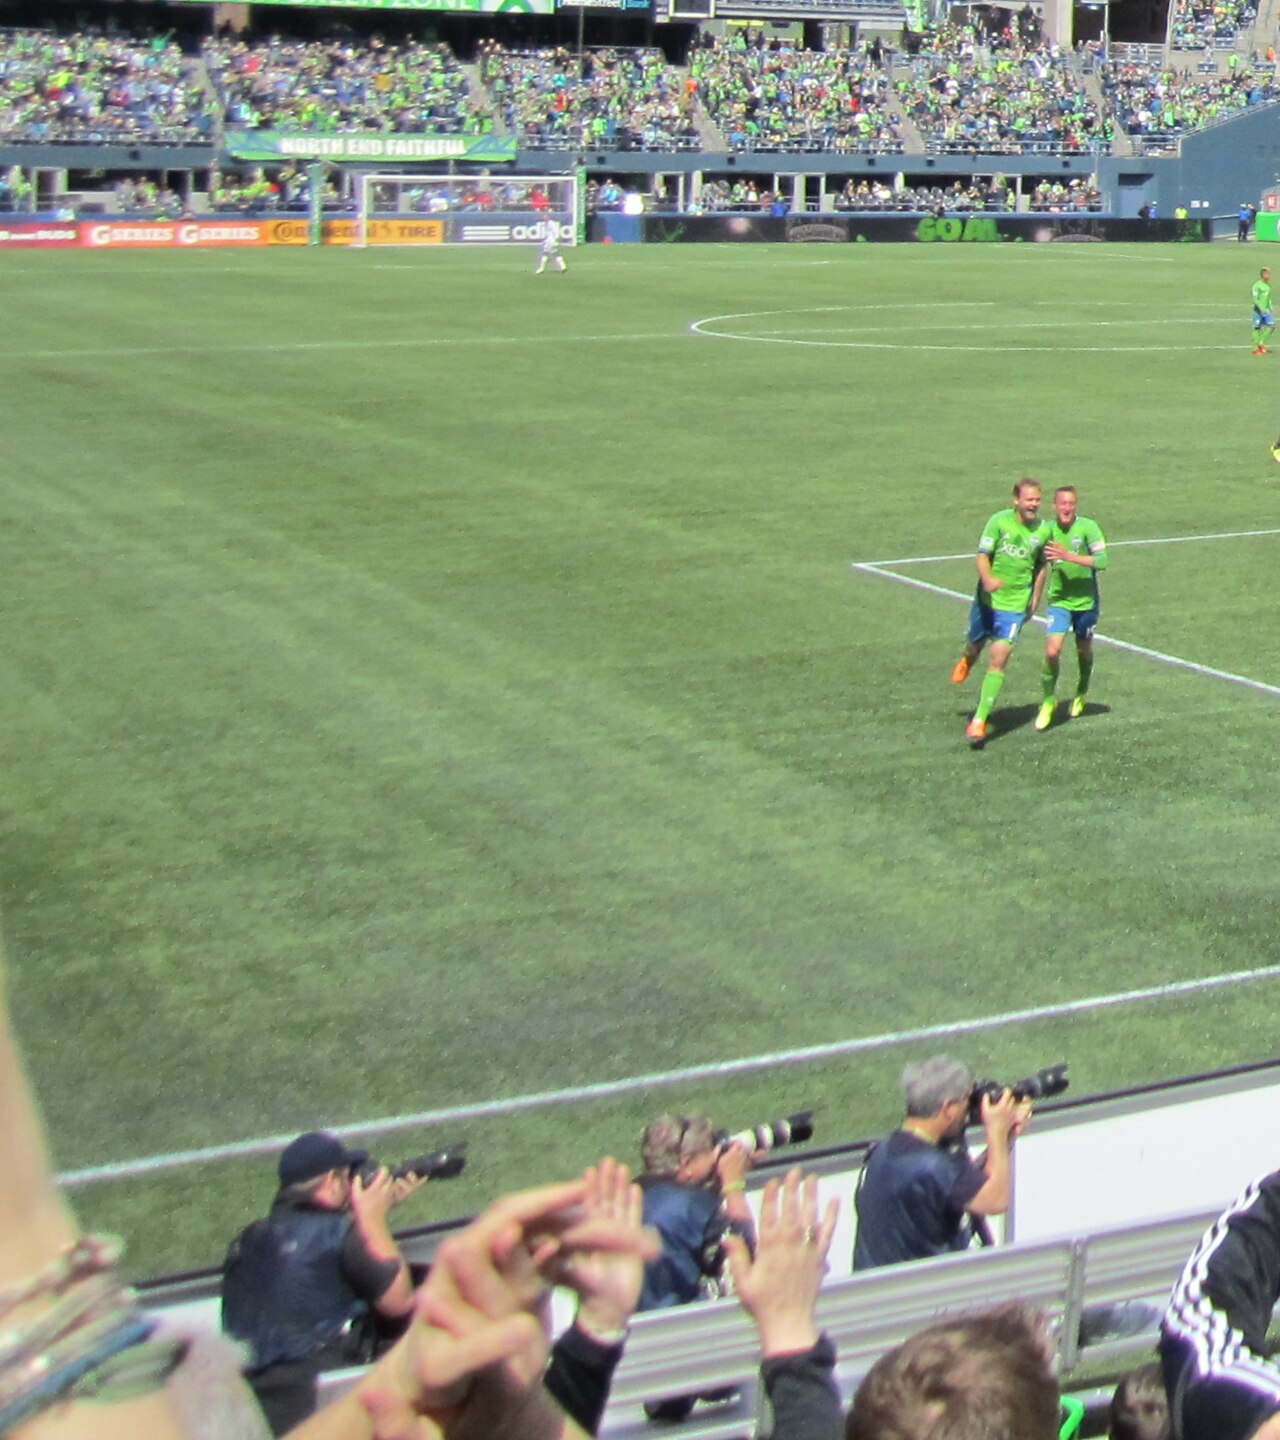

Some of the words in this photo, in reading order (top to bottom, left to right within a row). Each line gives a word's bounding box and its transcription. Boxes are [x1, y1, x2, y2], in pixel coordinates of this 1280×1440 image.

[280, 138, 344, 155] NORTH
[345, 139, 383, 155] END
[385, 140, 467, 155] FAITHFUL
[399, 226, 438, 239] TIRE
[918, 218, 999, 242] GOAL
